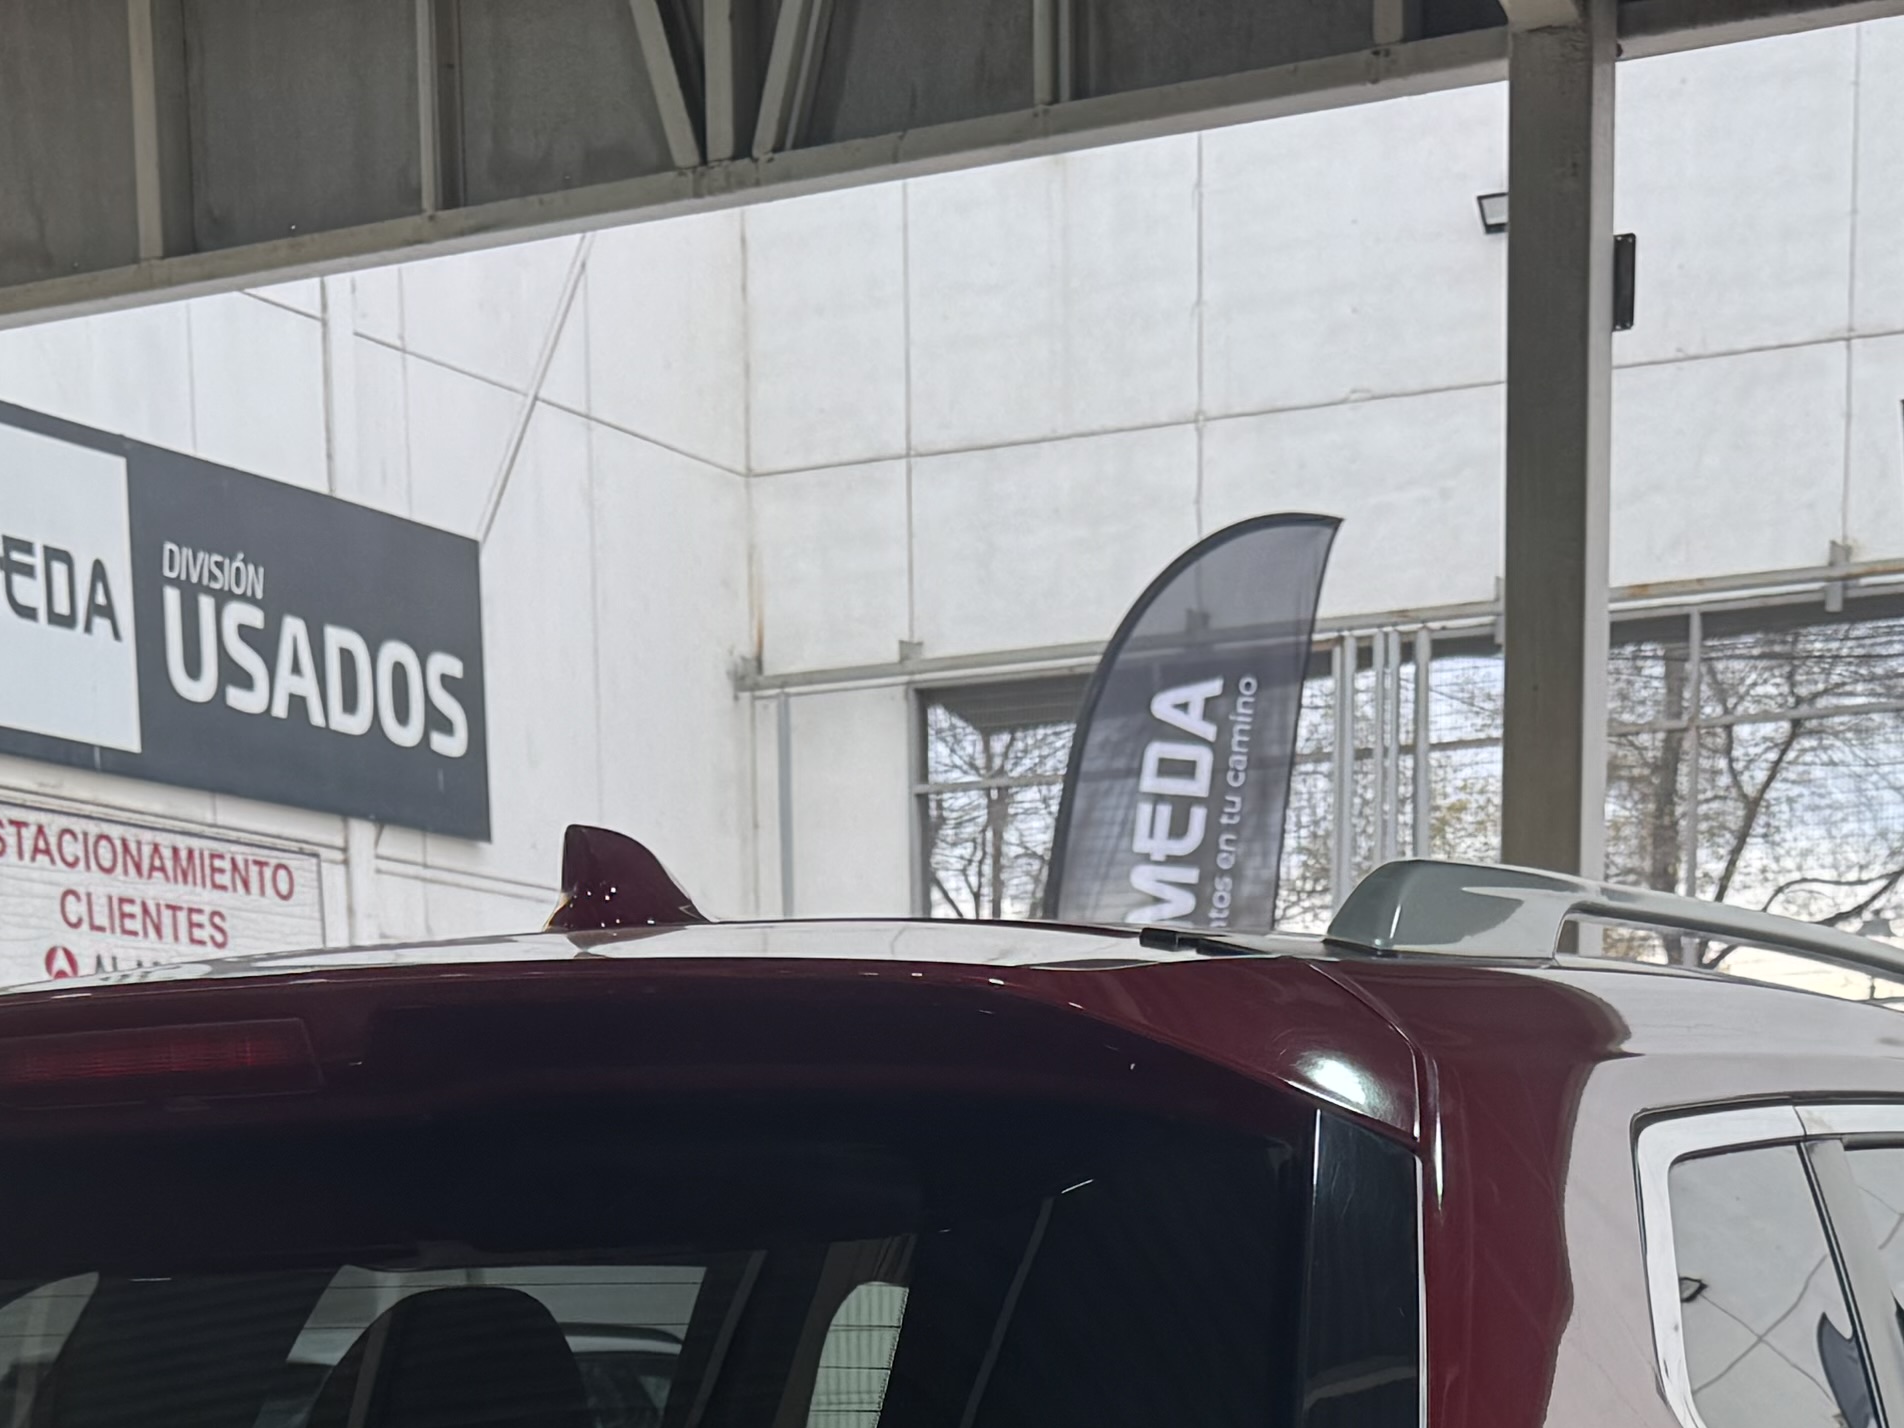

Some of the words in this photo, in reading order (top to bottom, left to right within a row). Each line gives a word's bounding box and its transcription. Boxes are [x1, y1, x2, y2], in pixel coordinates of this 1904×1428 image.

[162, 540, 265, 600] DIVISIÓN
[162, 585, 470, 758] USADOS
[60, 888, 229, 950] CLIENTES
